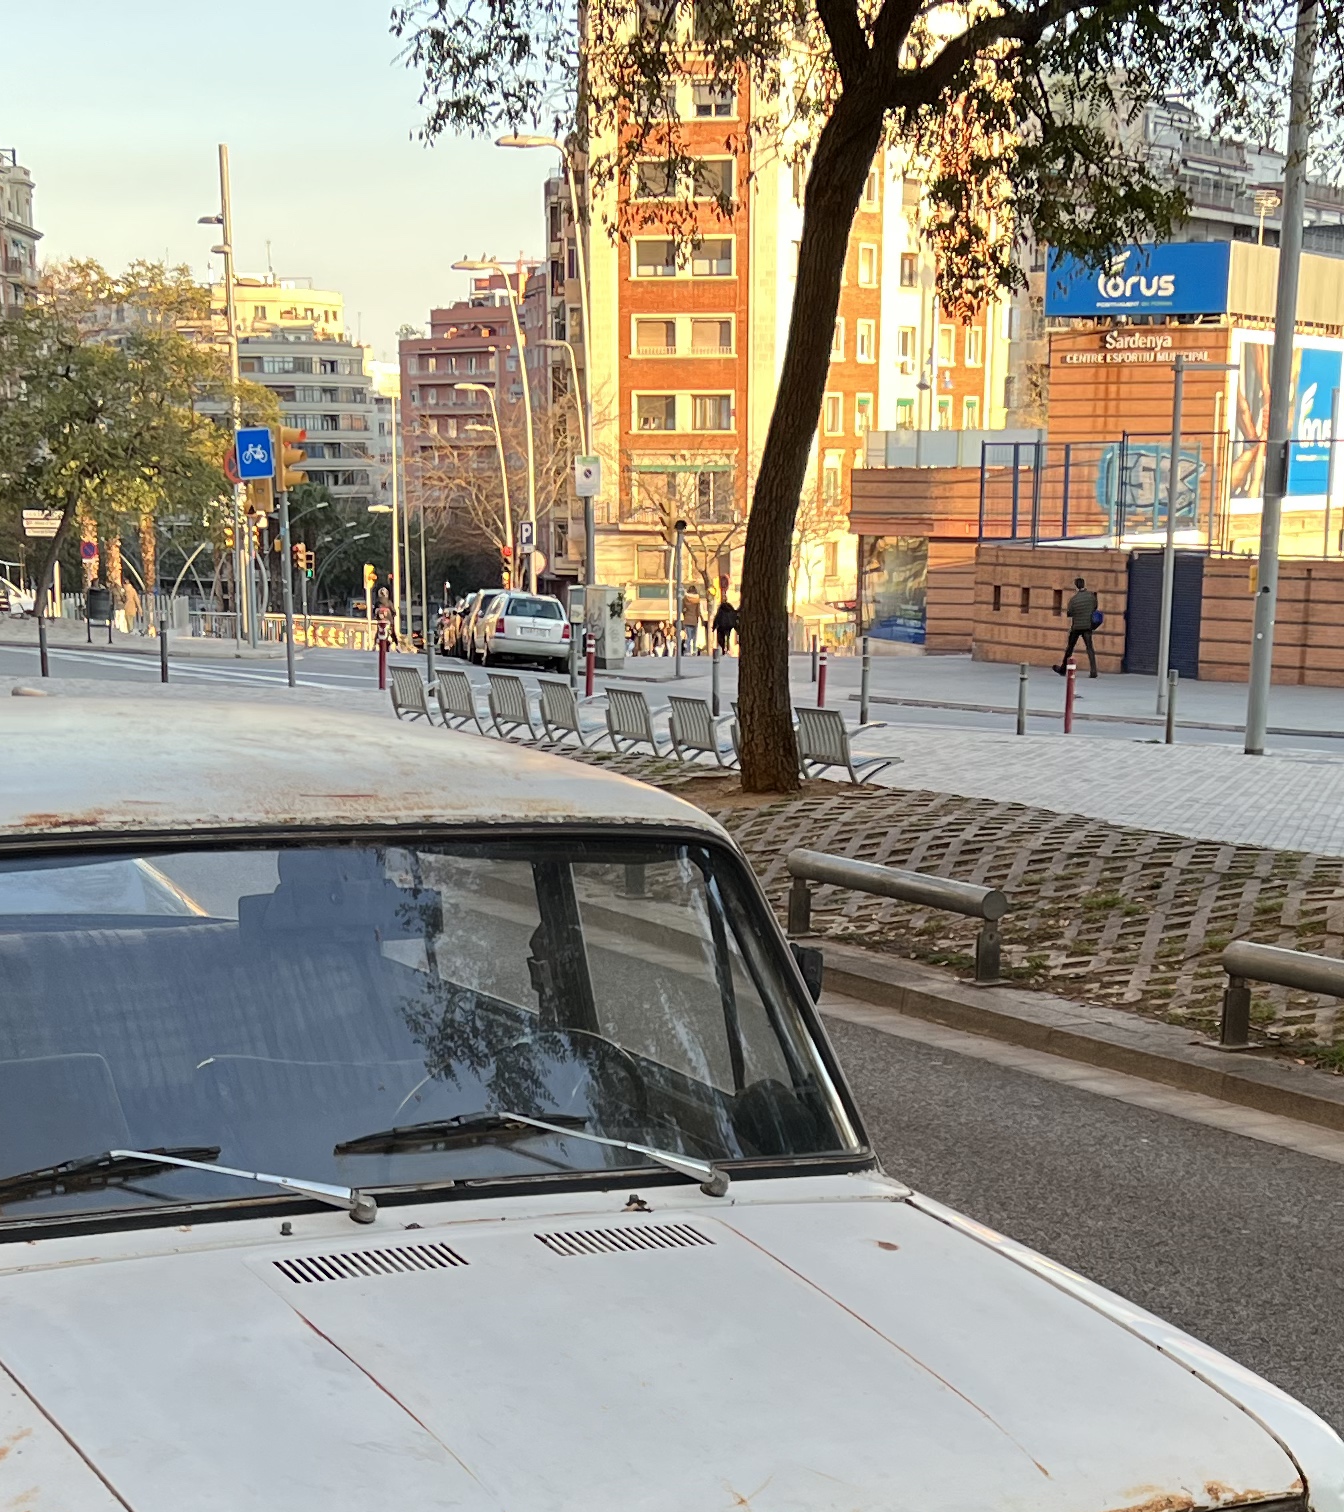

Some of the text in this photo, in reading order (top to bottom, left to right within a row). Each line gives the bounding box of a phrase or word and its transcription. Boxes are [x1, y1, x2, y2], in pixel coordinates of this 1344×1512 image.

[1105, 331, 1172, 350] Sardenya
[1066, 351, 1211, 364] CENTRE ESPORTIU MUNCIPAL
[522, 523, 532, 544] P
